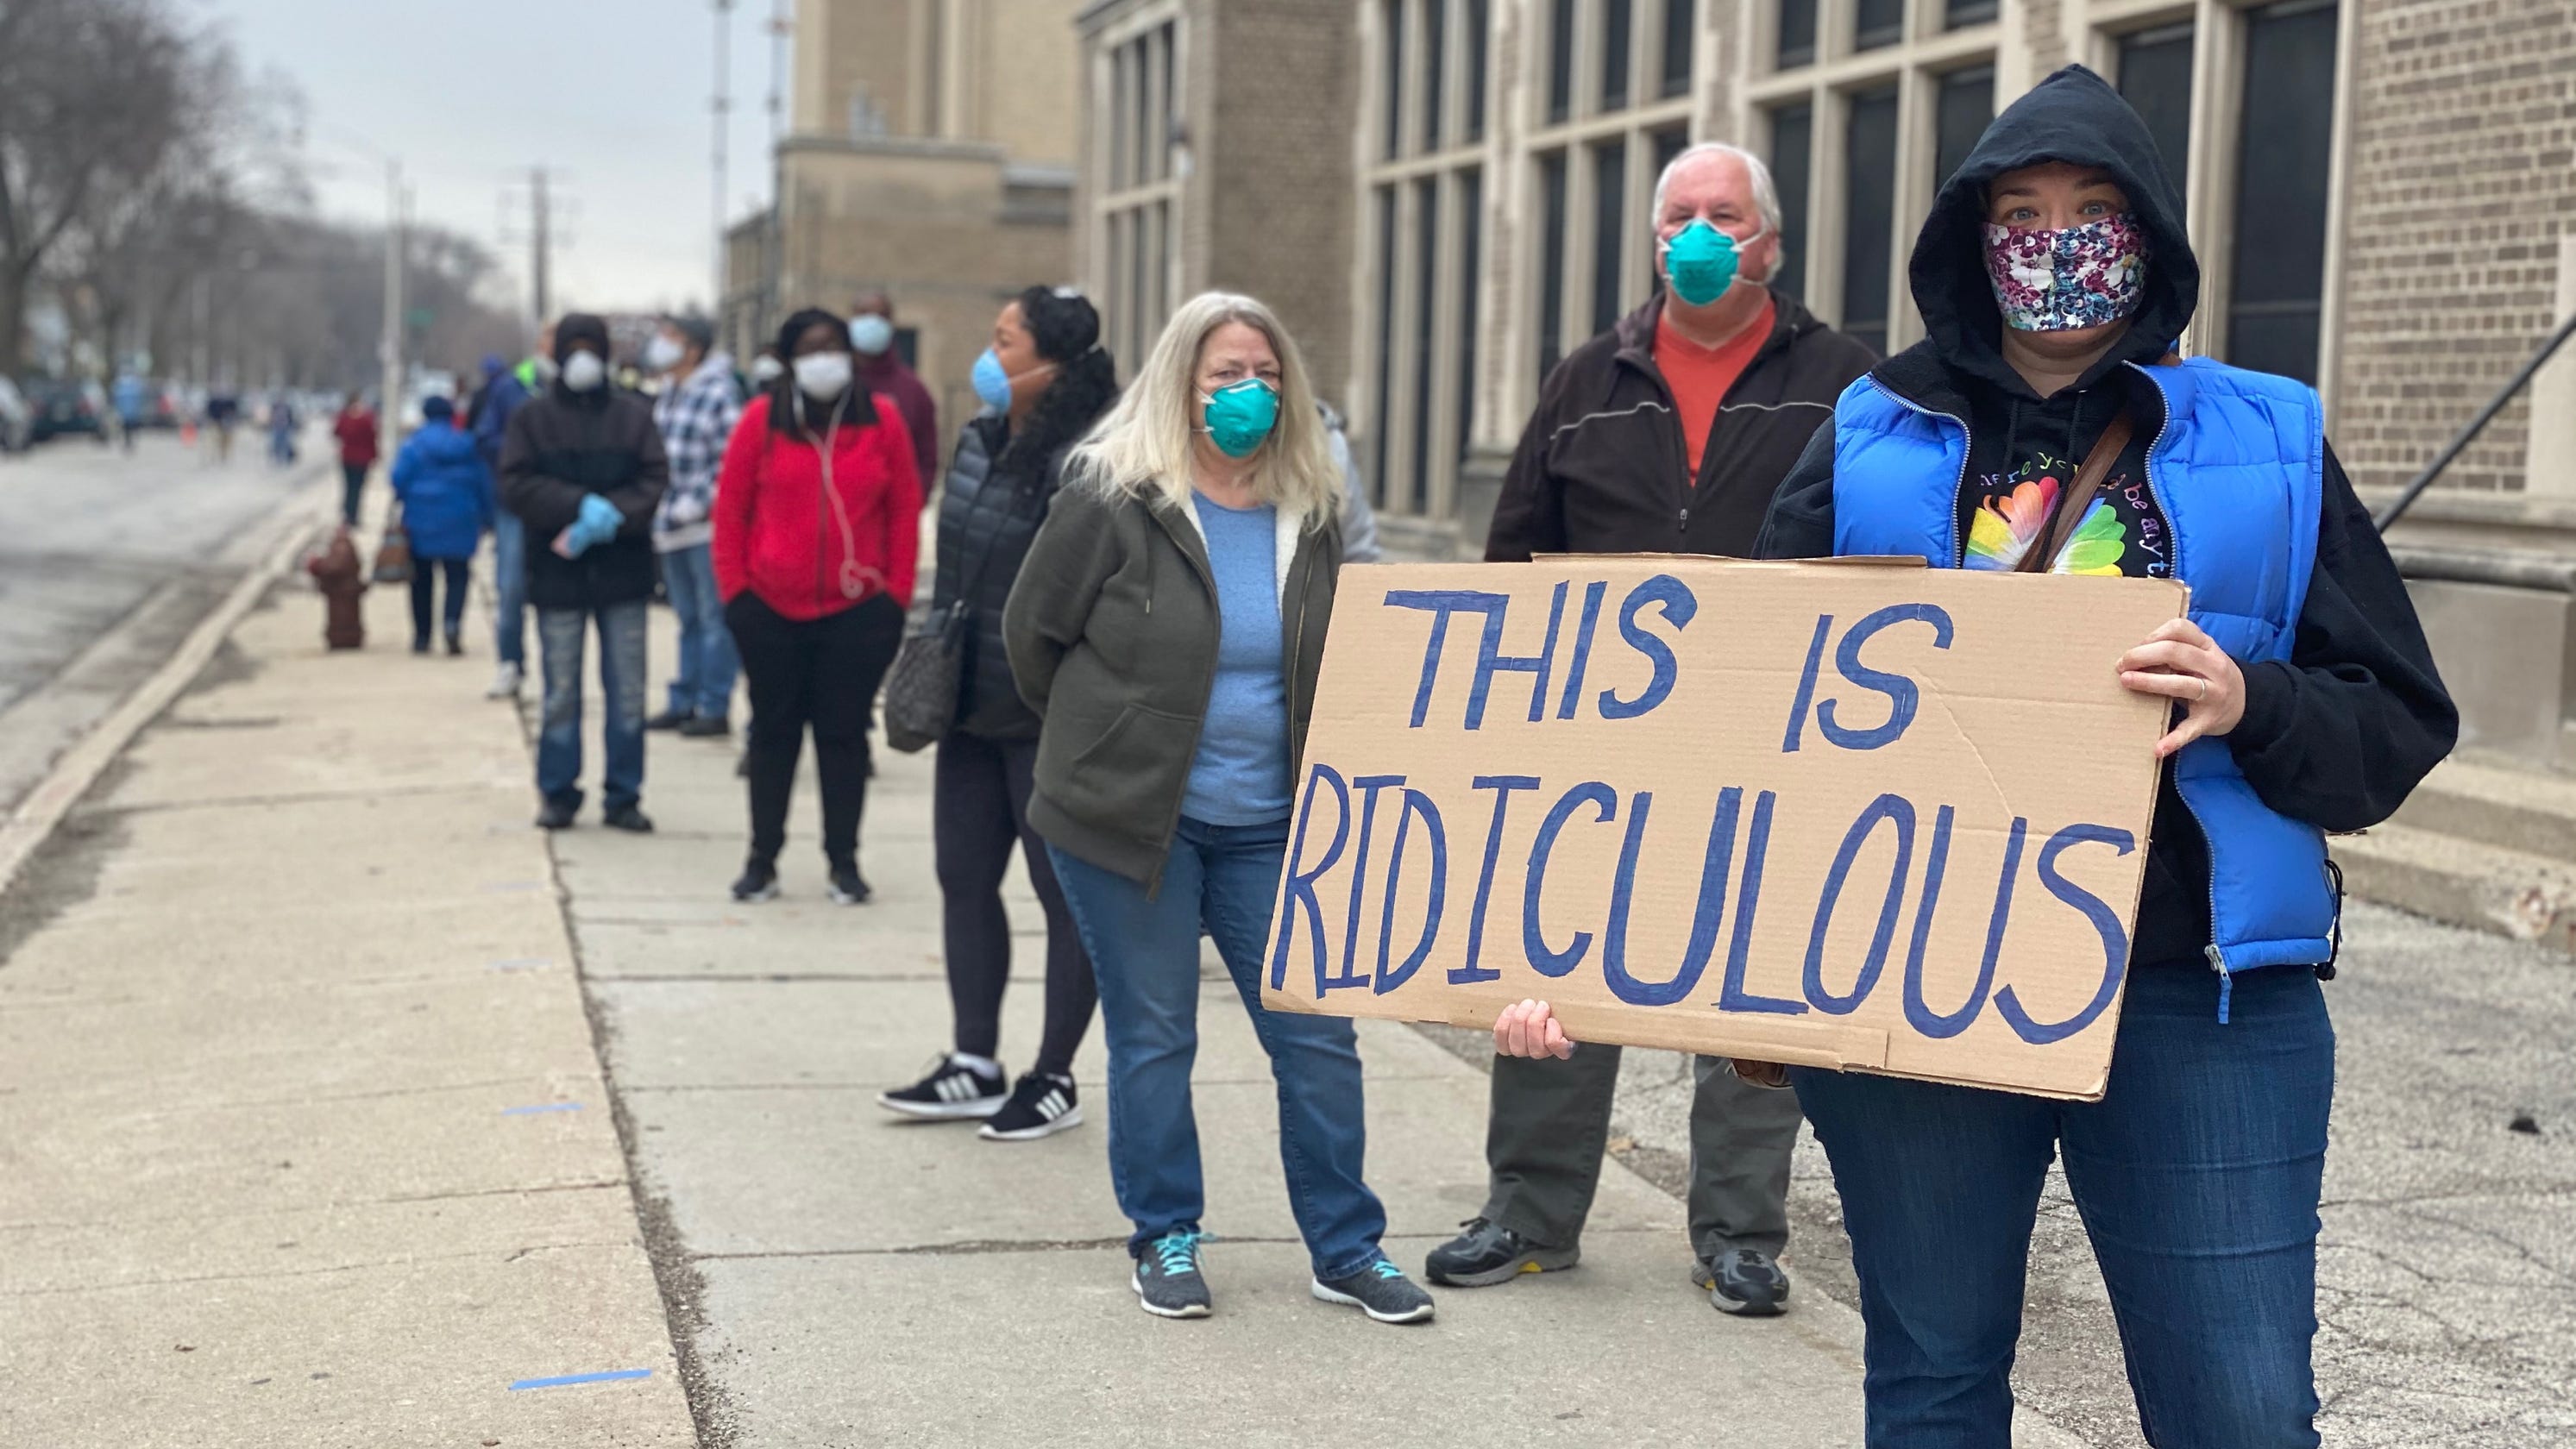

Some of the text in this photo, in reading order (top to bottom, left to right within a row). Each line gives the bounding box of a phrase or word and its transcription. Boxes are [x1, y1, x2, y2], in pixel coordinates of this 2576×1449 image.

[2124, 482, 2149, 510] be
[1385, 574, 1954, 753] THIS IS
[1271, 762, 2136, 1044] RIDICULOUS
